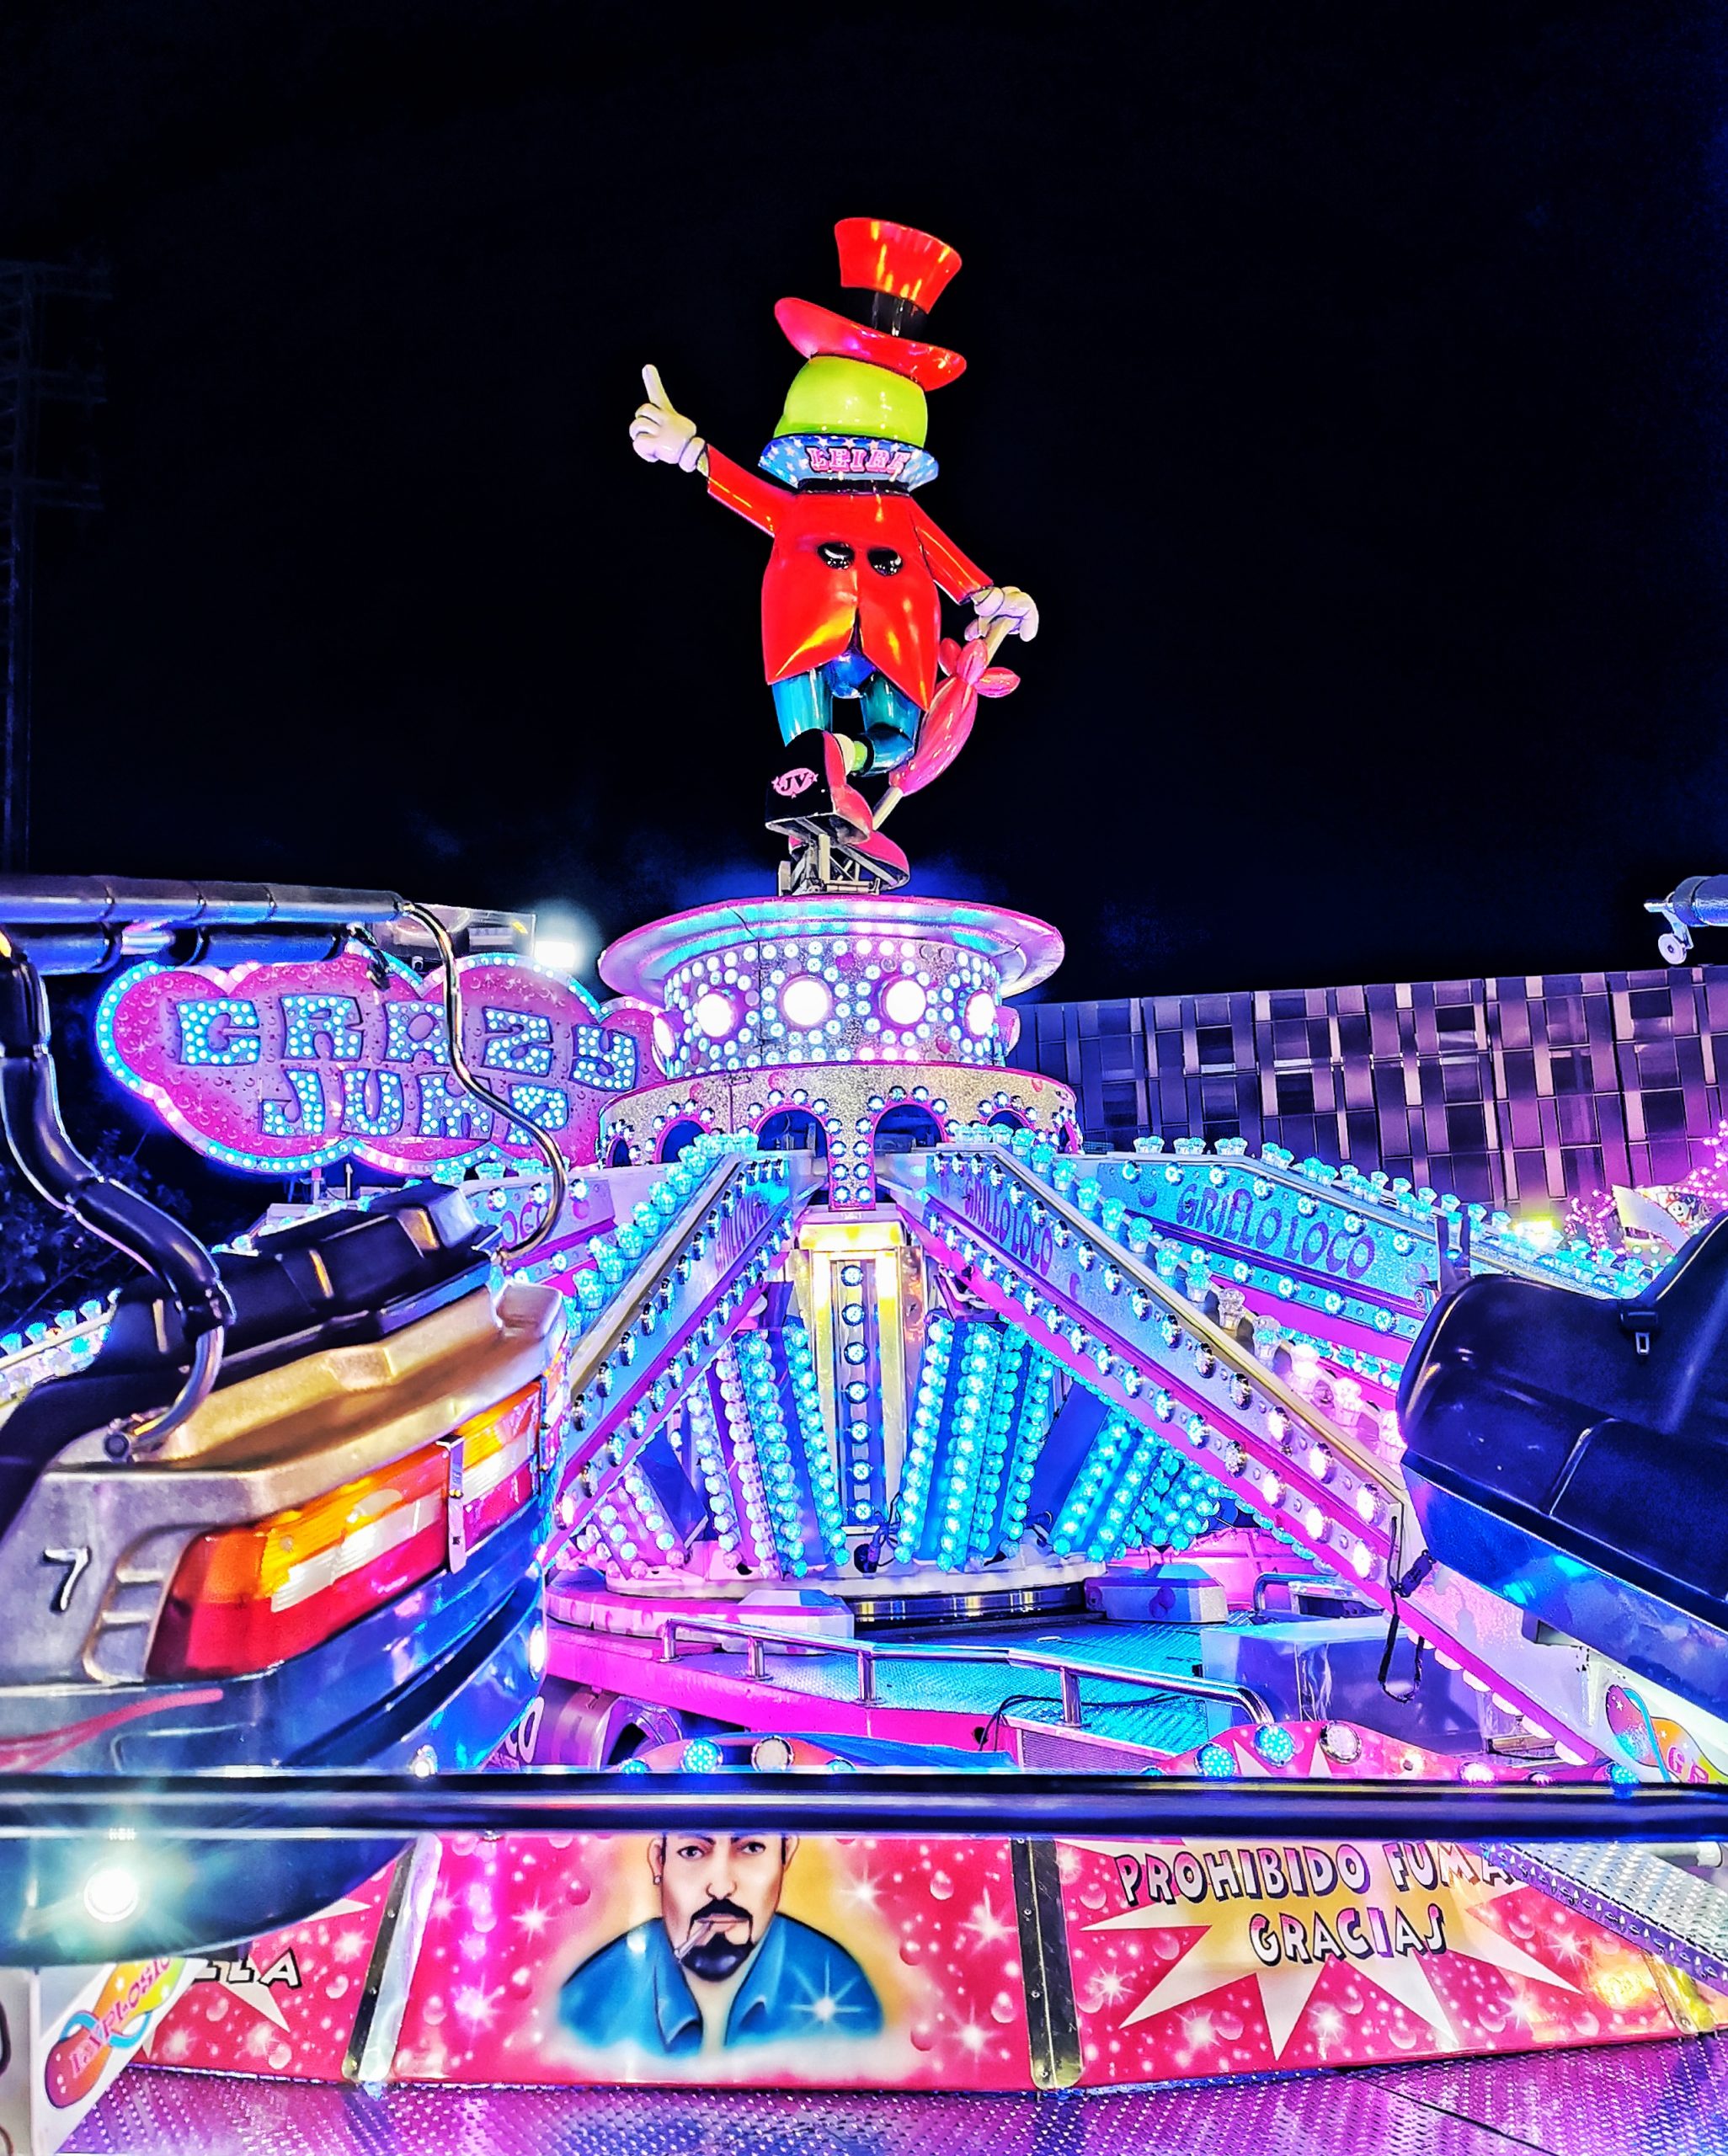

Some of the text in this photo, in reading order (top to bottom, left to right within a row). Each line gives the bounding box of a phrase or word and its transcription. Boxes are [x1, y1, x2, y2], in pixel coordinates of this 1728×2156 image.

[781, 771, 809, 792] JV
[260, 1069, 569, 1146] JUMP
[1283, 1214, 1376, 1280] LOCO
[42, 1546, 92, 1615] 7
[1115, 1844, 1371, 1906] PROHIBIDO
[1250, 1903, 1448, 1967] GRACIAS
